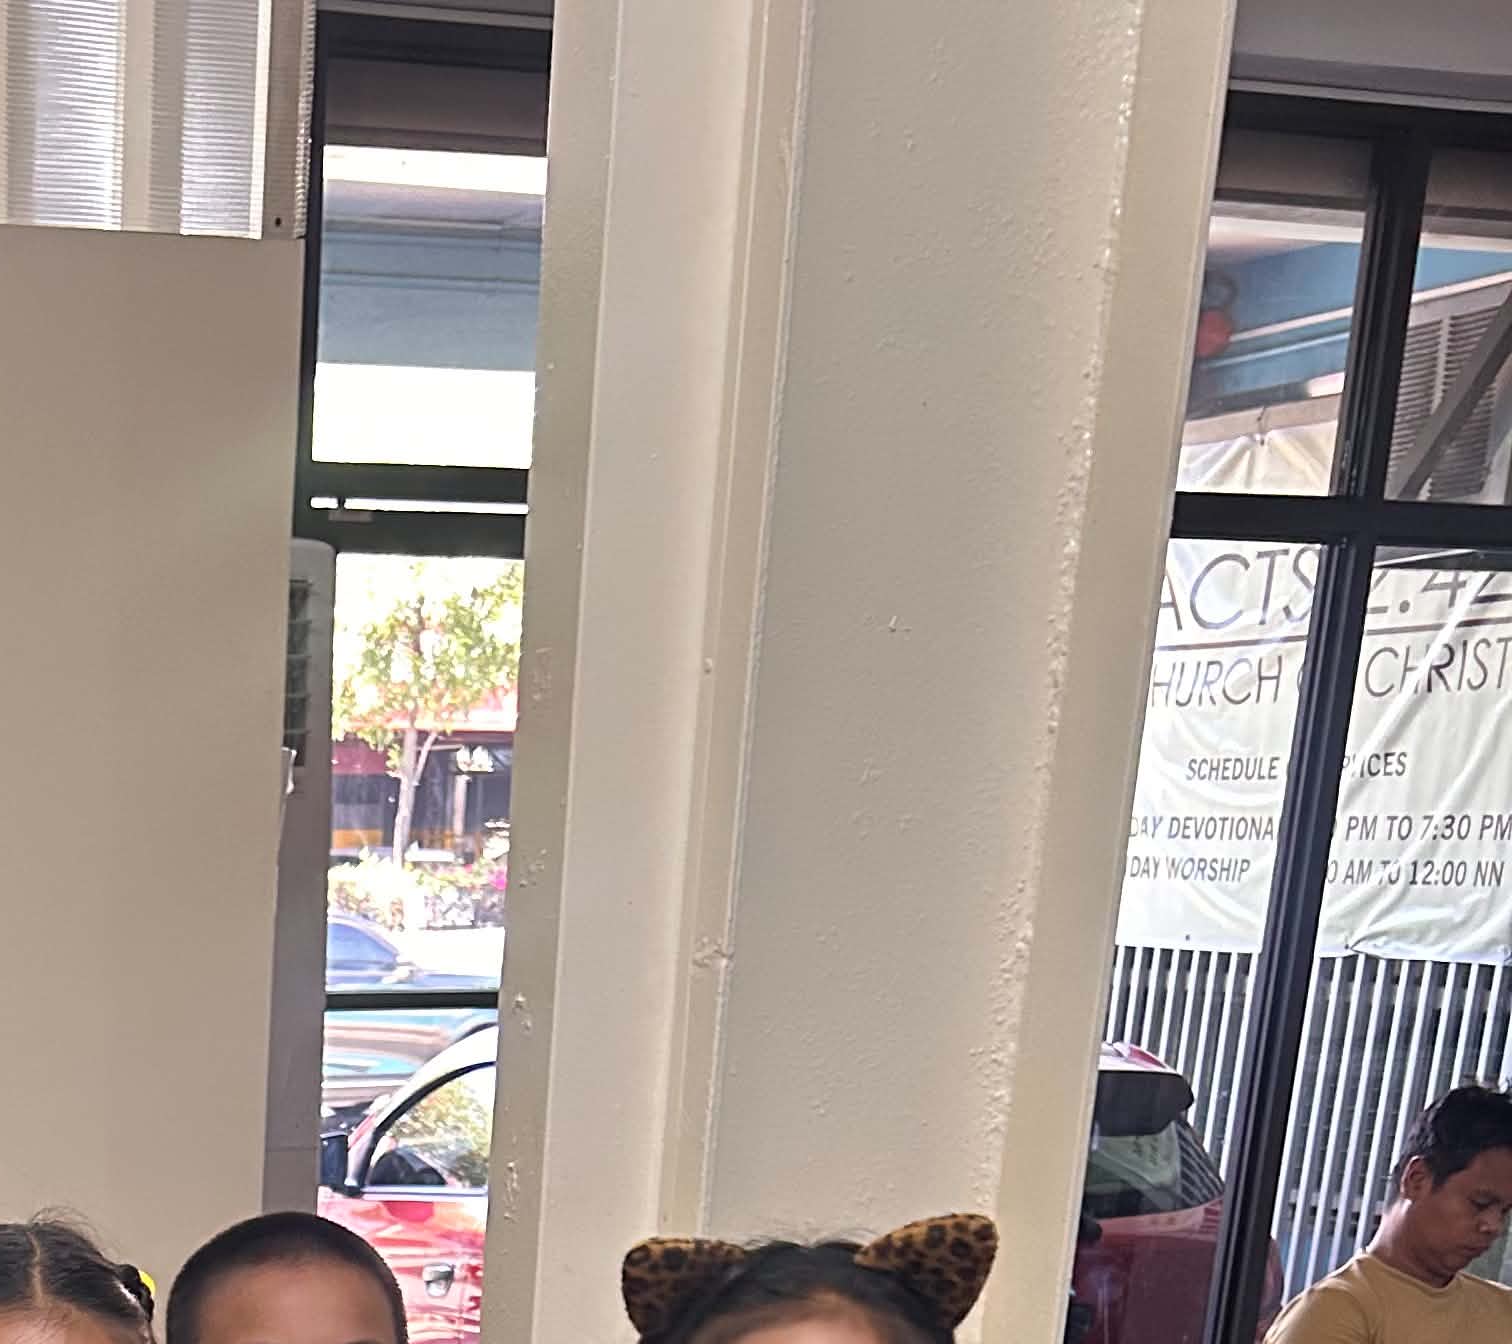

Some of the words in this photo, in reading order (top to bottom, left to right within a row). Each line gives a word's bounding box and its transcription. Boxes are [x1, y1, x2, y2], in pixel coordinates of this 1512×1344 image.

[1160, 546, 1318, 631] ACTS
[1365, 636, 1512, 698] CHRIST
[1186, 756, 1280, 781] SCHEDULE
[1345, 815, 1378, 841] PM
[1387, 815, 1413, 841] TO
[1420, 815, 1472, 841] 7:30
[1479, 814, 1512, 841] PM
[1166, 856, 1251, 883] WORSHIP
[1342, 859, 1373, 884] AM
[1379, 860, 1401, 886] TO
[1409, 860, 1468, 886] 12:00
[1473, 861, 1505, 887] NN
